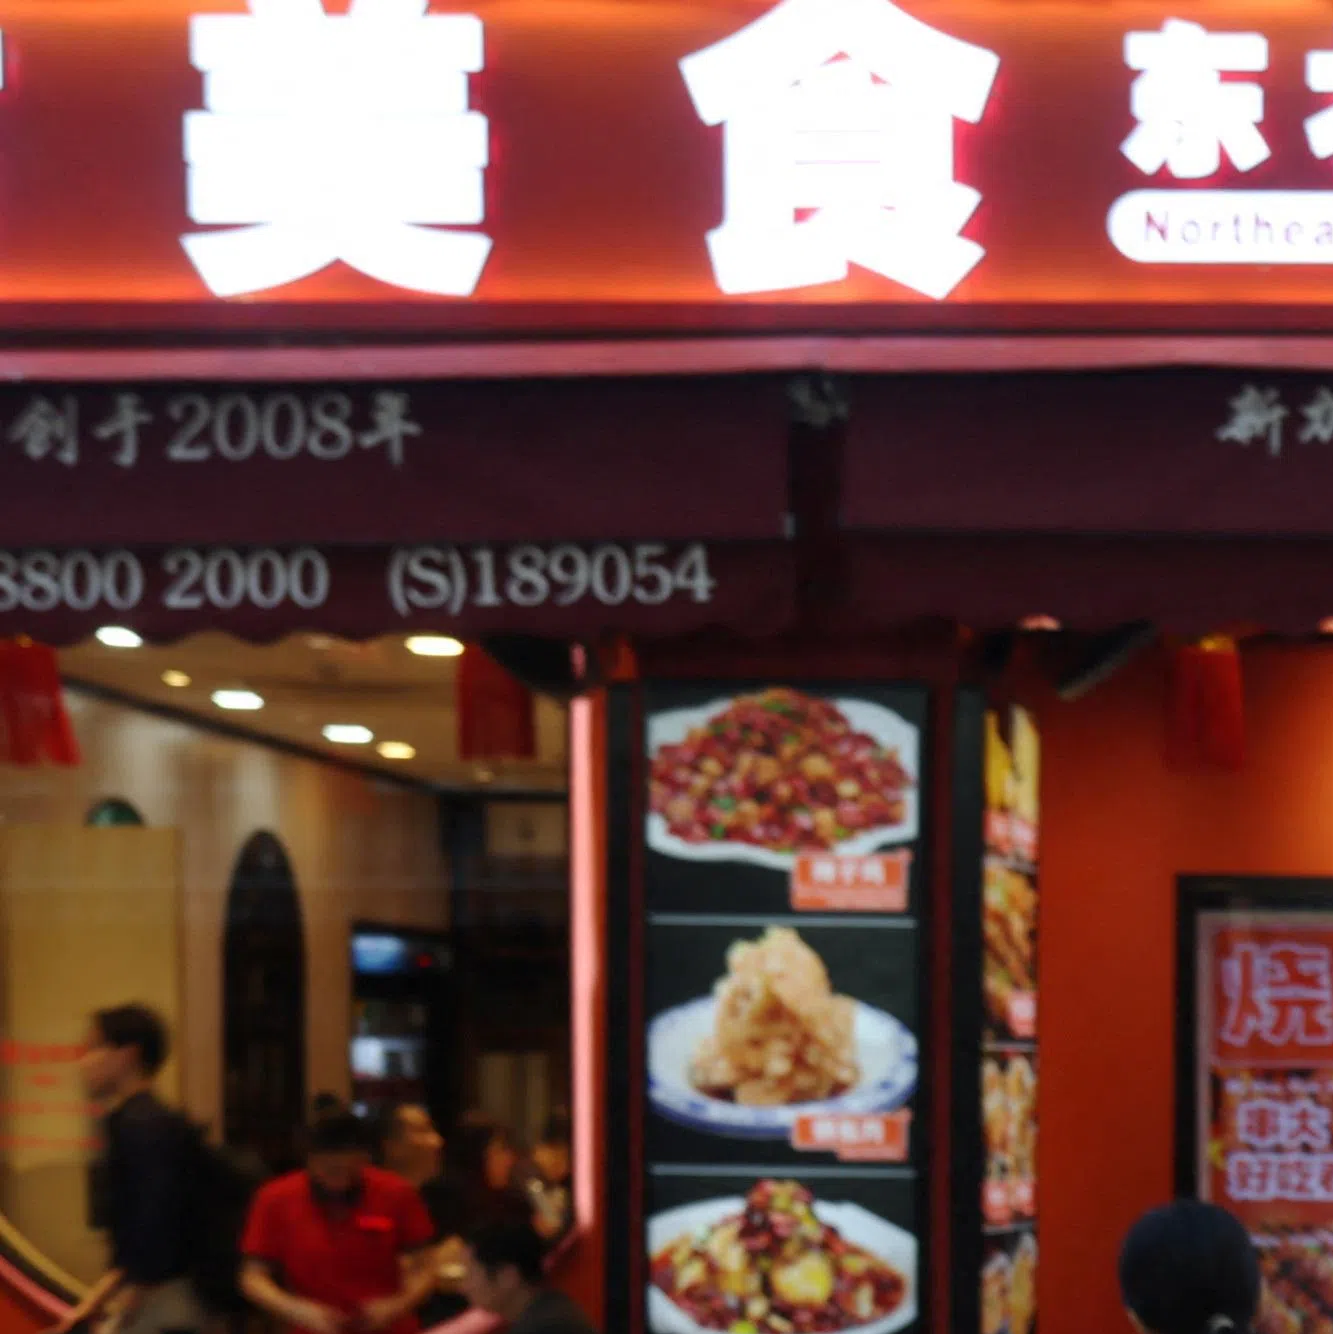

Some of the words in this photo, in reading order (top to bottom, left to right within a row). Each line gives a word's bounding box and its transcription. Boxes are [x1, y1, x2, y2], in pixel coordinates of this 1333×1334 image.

[181, 0, 1001, 299] 美食
[163, 549, 330, 609] 2000
[388, 546, 715, 614] (S)189054
